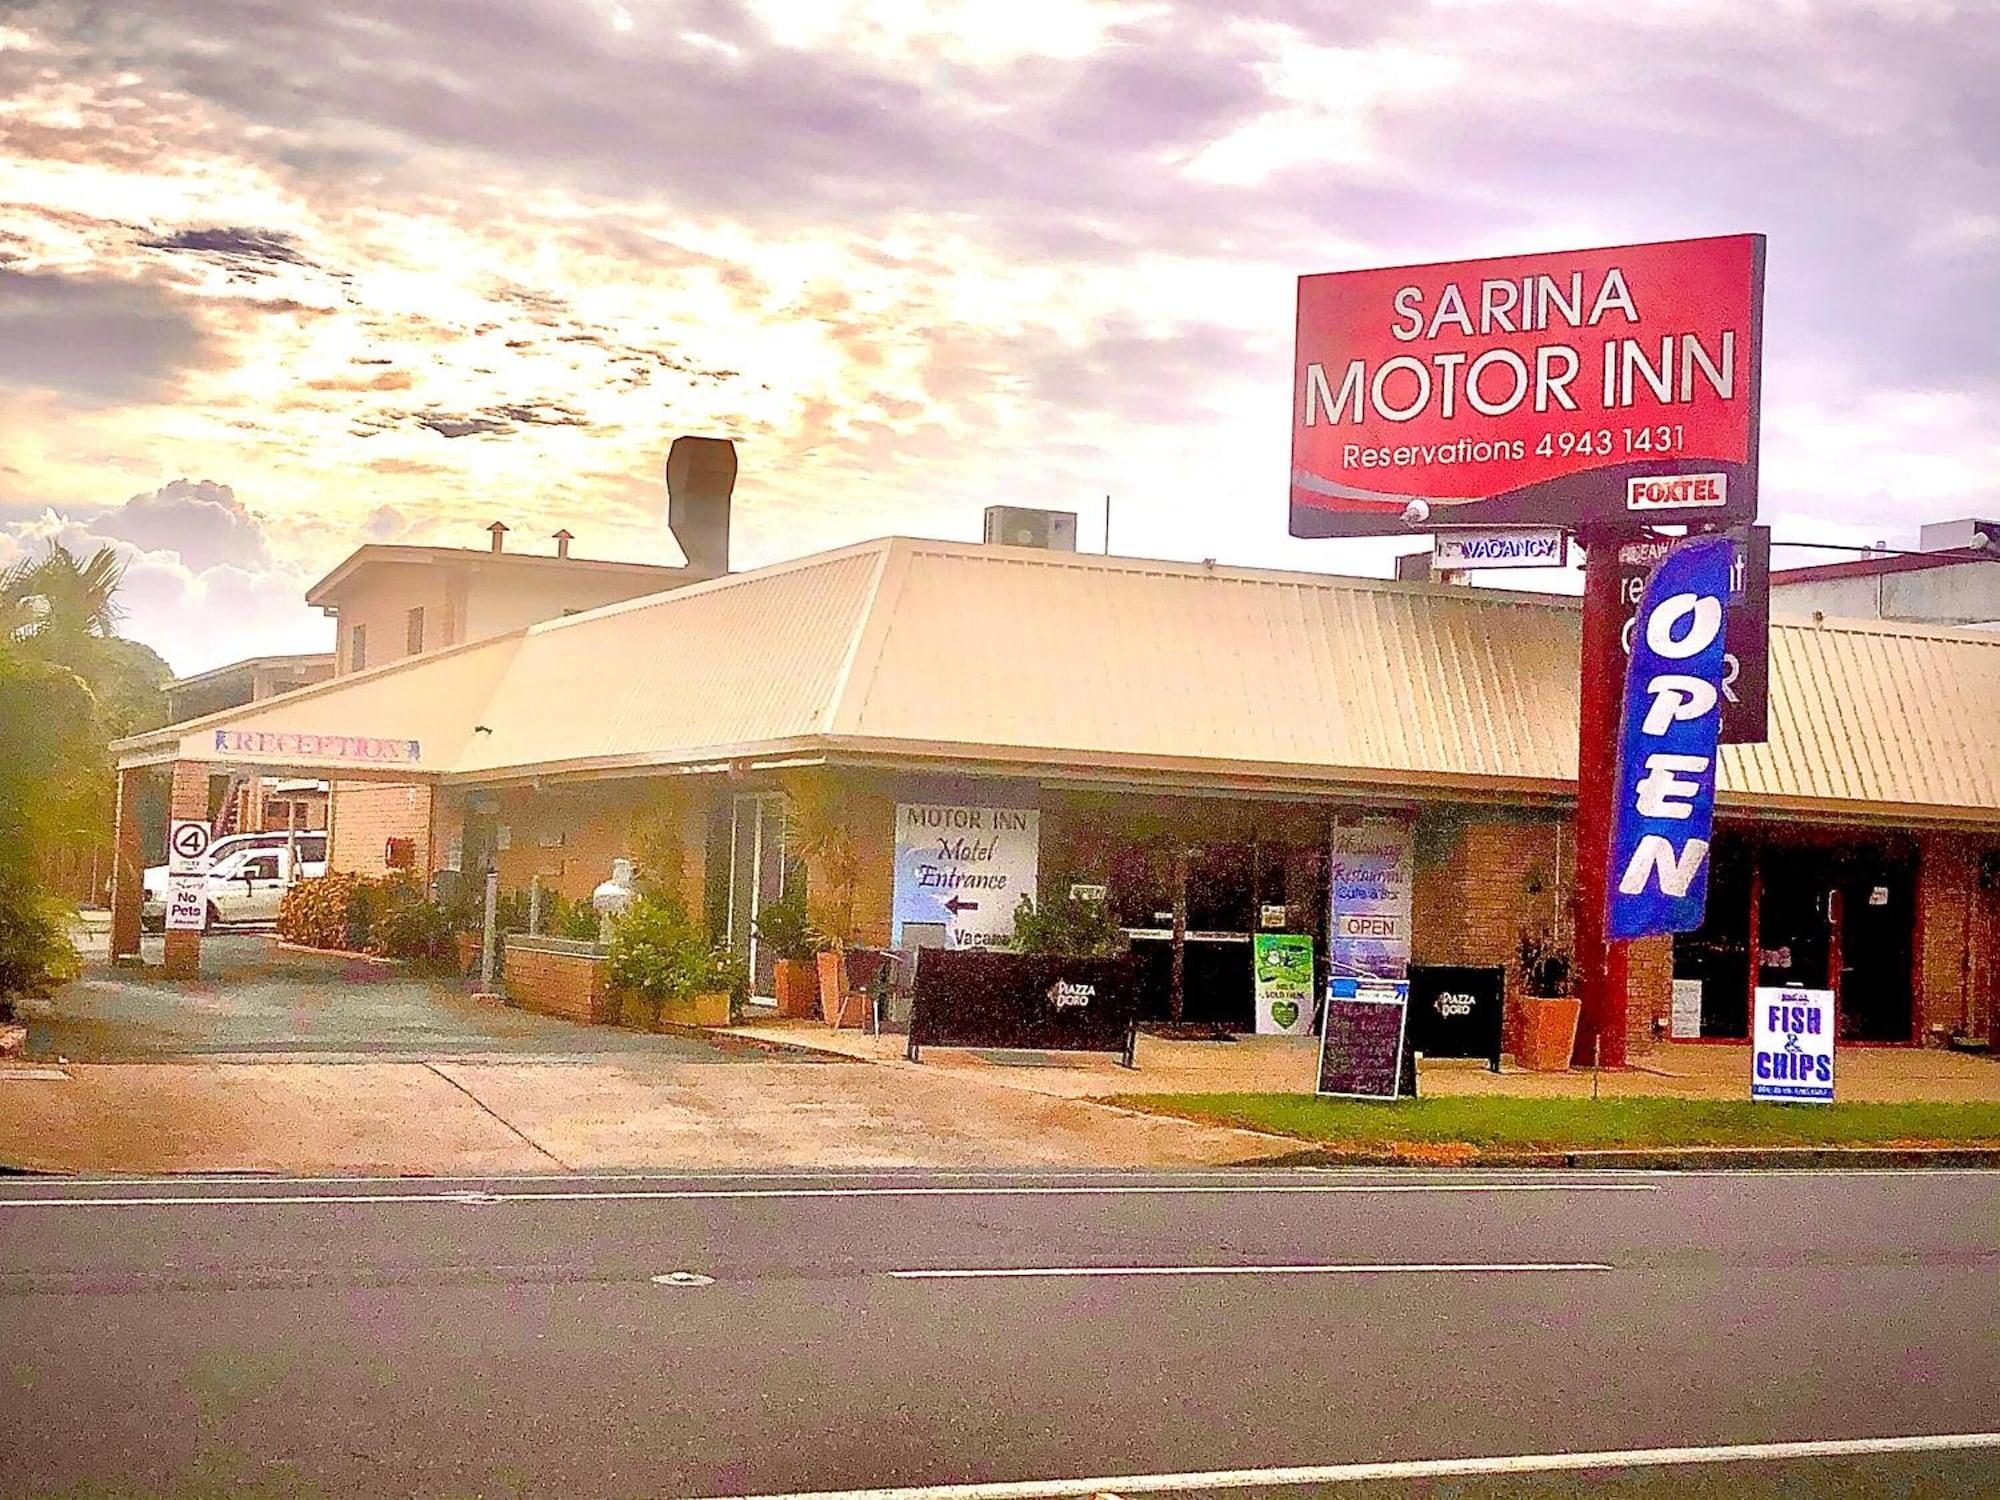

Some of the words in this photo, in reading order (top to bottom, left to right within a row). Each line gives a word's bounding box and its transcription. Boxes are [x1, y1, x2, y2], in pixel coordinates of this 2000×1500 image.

[1391, 268, 1639, 342] SARINA
[1304, 344, 1580, 428] MOTOR
[1602, 330, 1735, 409] INN
[1342, 435, 1526, 469] Reservations
[1534, 428, 1613, 459] 4943
[1621, 424, 1685, 454] 1431
[1631, 478, 1720, 504] FOXTEL
[1466, 539, 1556, 558] VACANCY
[1618, 592, 1723, 898] OPEN
[906, 806, 983, 830] MOTOR
[993, 811, 1027, 831] INN
[179, 831, 201, 852] 4
[936, 835, 999, 862] Motel
[918, 864, 1008, 890] Entrance
[171, 904, 202, 918] Pets
[177, 892, 198, 904] No
[1347, 918, 1395, 937] OPEN
[1768, 1005, 1821, 1034] FISH
[1784, 1033, 1803, 1053] &
[1756, 1051, 1831, 1082] CHIPS
